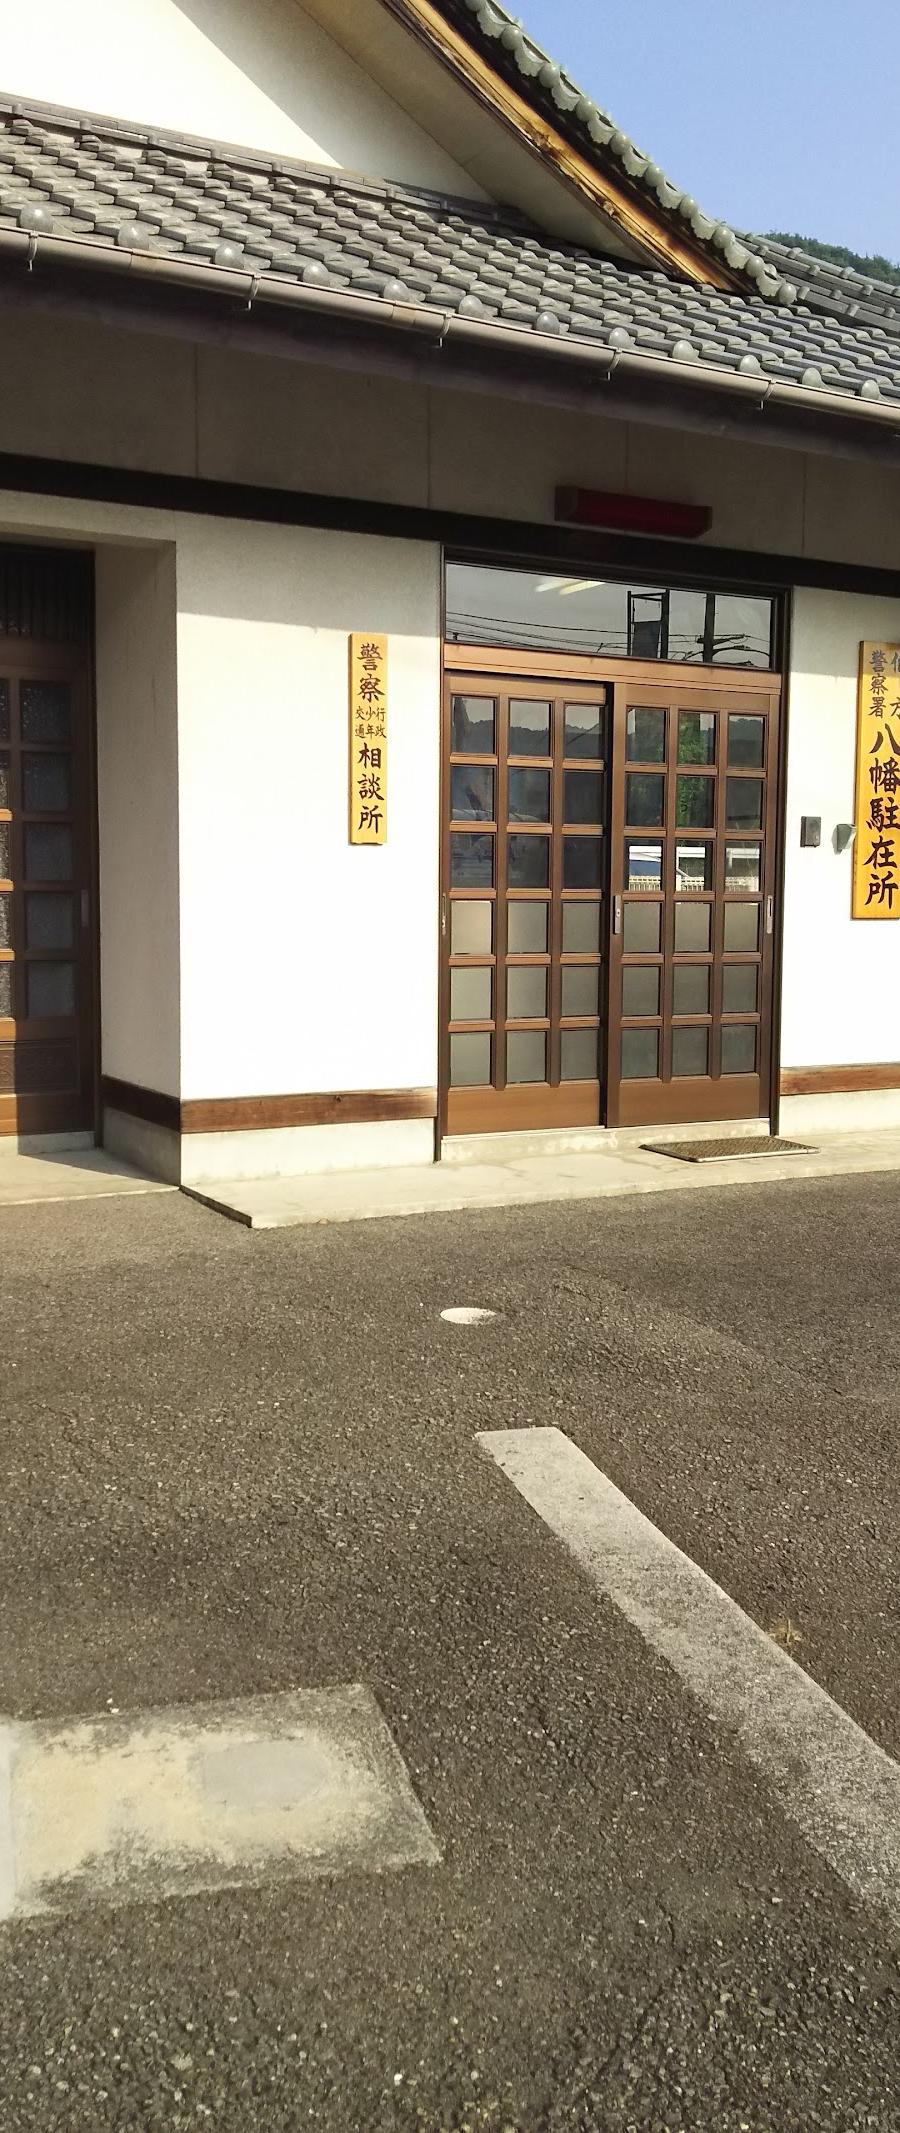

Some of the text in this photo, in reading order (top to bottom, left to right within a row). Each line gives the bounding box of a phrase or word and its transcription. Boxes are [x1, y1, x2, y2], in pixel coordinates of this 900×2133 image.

[357, 643, 385, 702] 警察
[868, 649, 888, 719] 警察署
[354, 705, 366, 739] 交通
[365, 705, 376, 740] 少年
[376, 706, 387, 738] 行政
[357, 742, 385, 834] 相談所
[863, 723, 900, 909] 八幡駐在所
